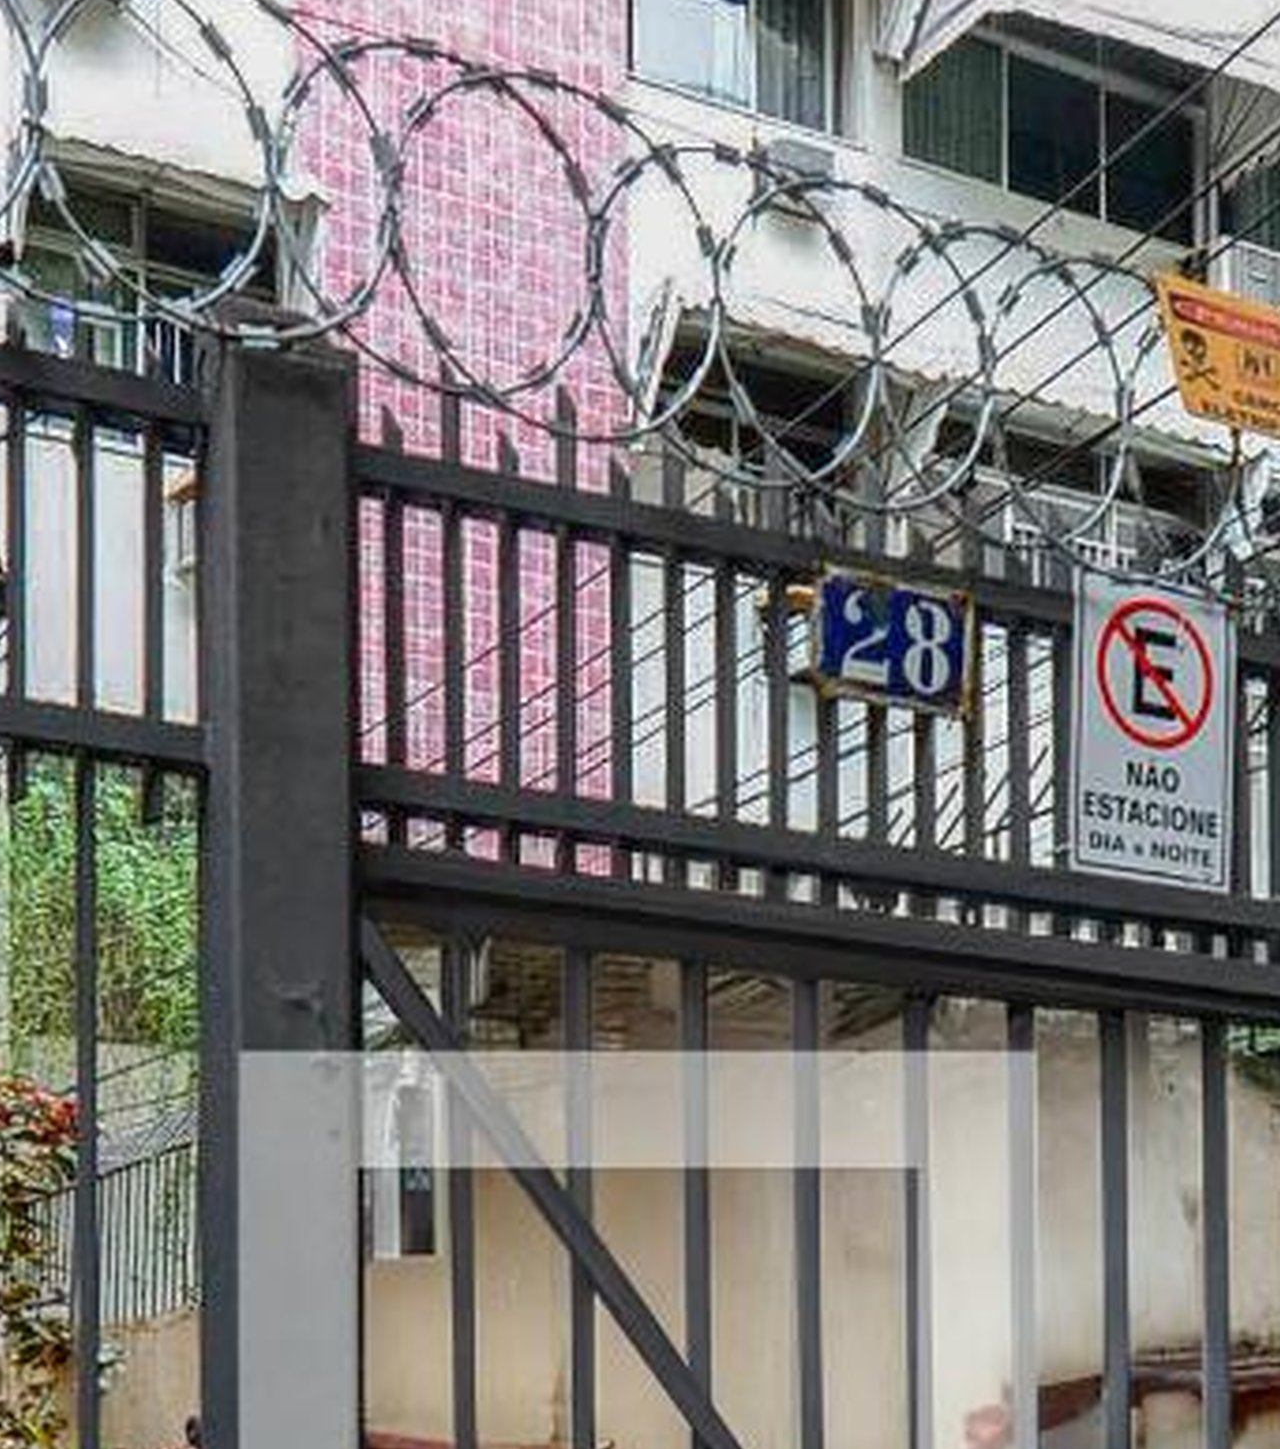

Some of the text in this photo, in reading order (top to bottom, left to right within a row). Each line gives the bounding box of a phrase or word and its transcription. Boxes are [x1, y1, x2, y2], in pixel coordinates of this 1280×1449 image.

[841, 591, 950, 695] 28
[1134, 627, 1179, 720] E
[1083, 789, 1219, 839] ESTACIONE
[1089, 831, 1126, 852] DIA
[1150, 841, 1213, 869] NOITE
